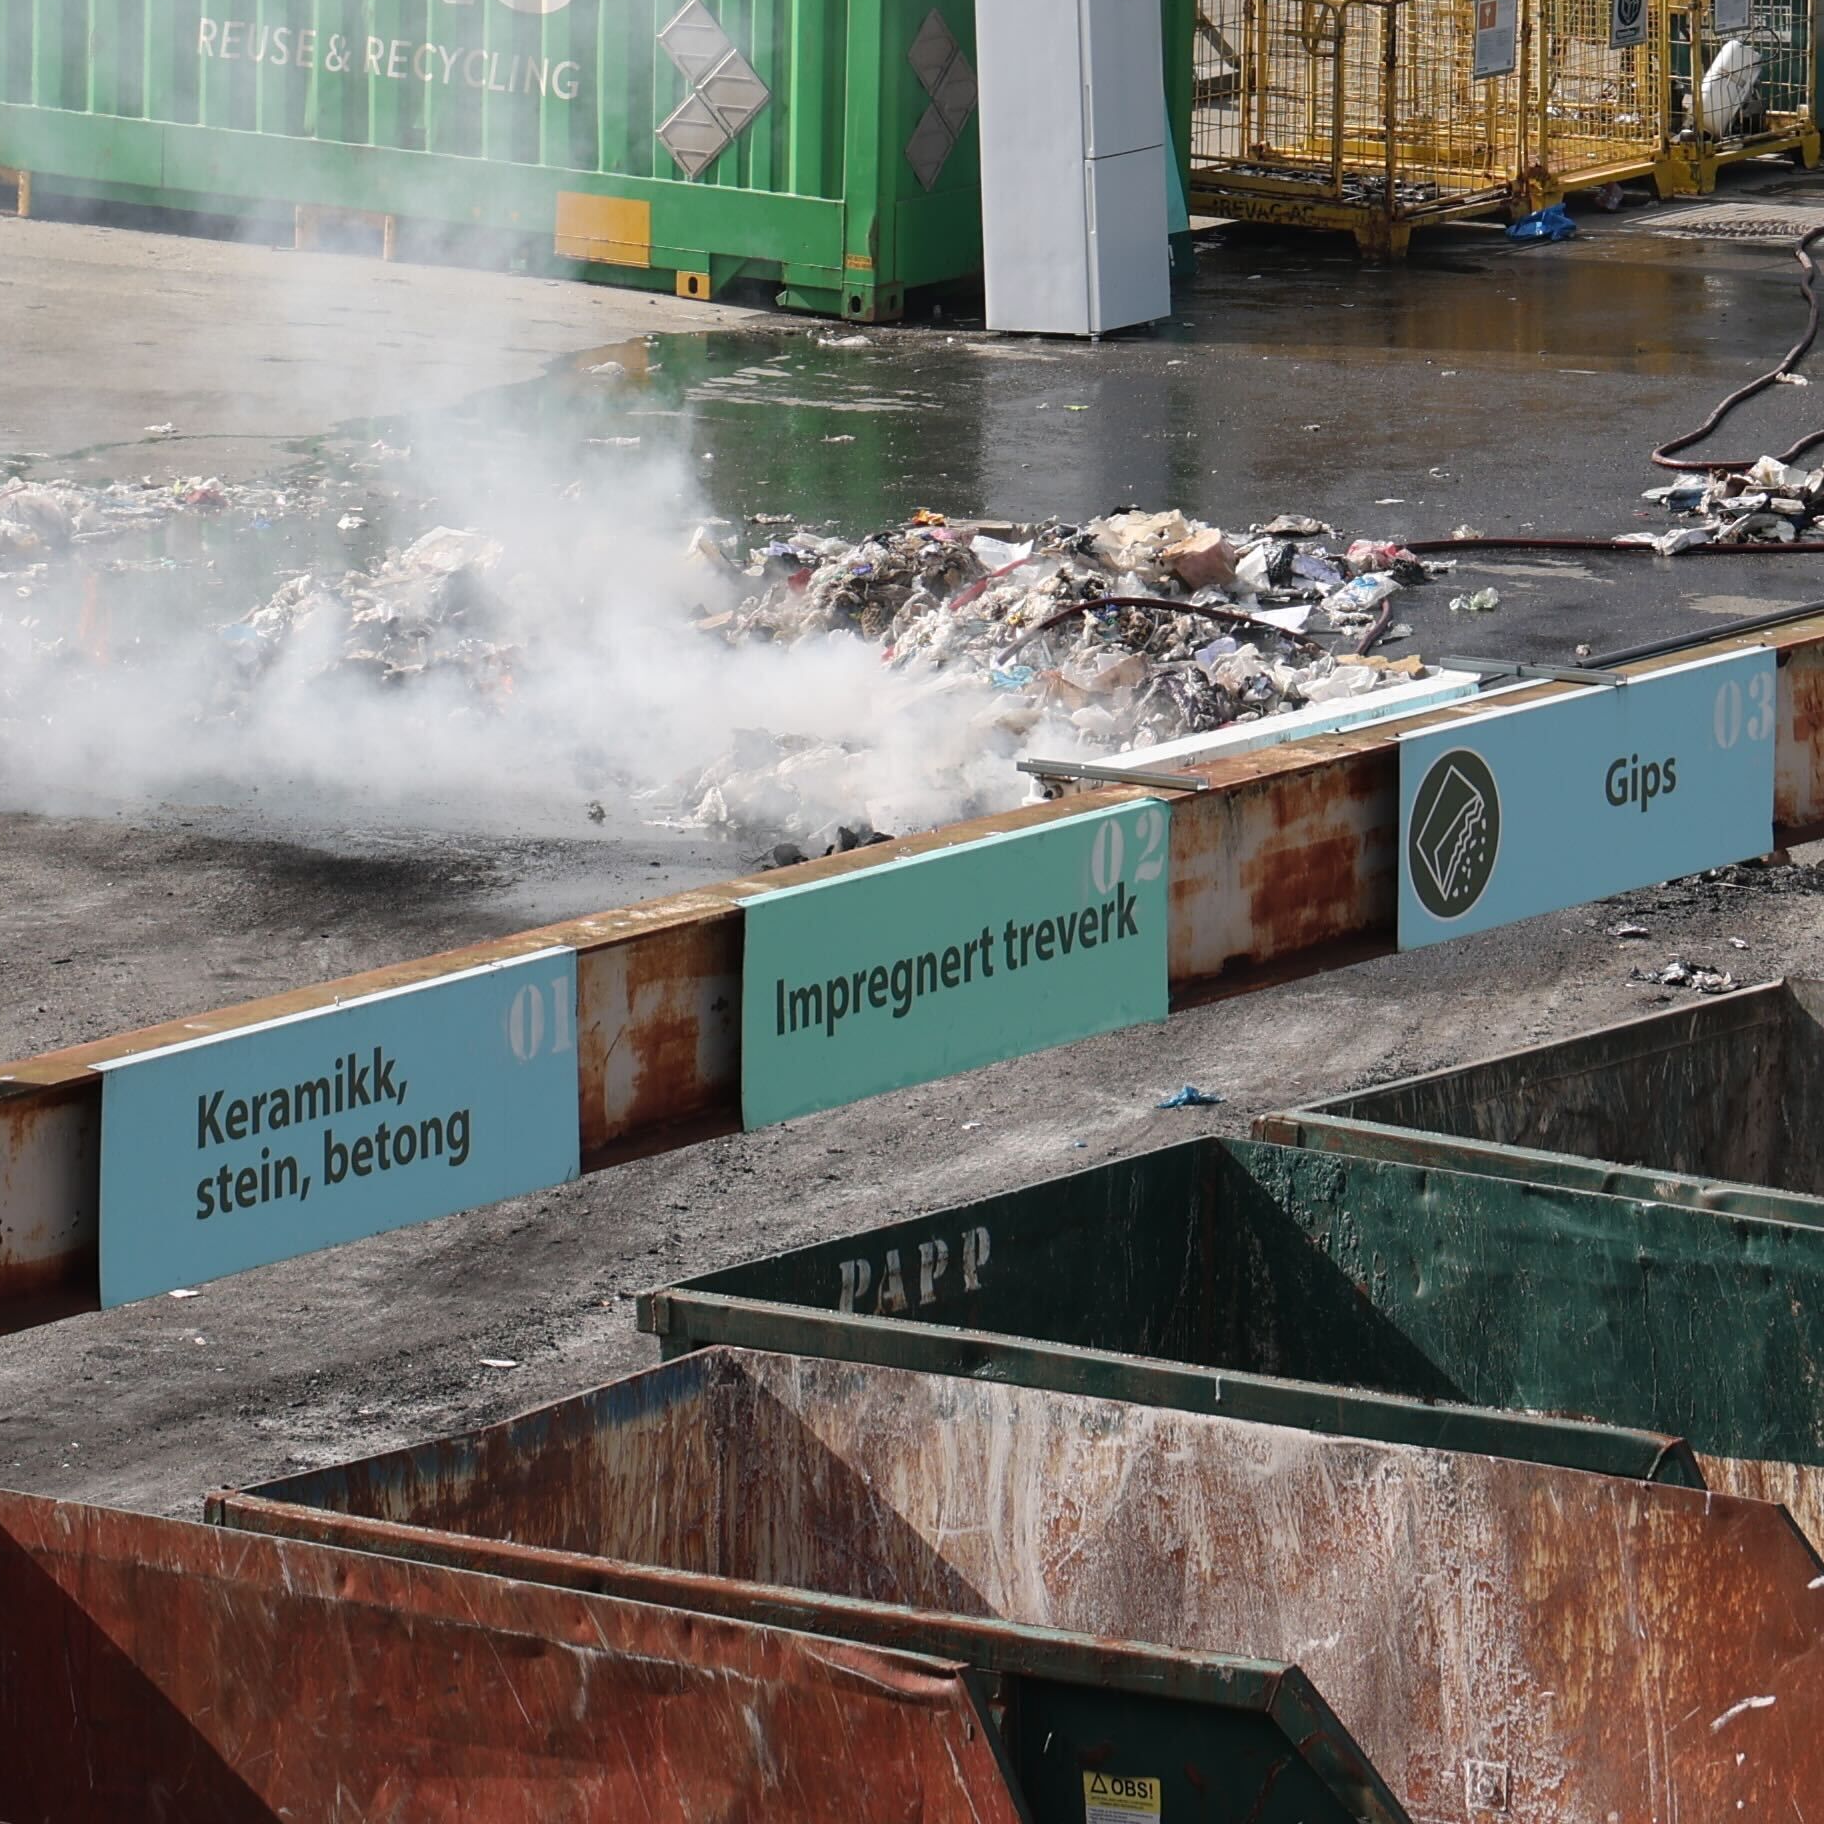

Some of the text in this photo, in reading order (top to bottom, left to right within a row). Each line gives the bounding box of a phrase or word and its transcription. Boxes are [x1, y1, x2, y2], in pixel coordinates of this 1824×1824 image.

[198, 17, 583, 101] REUSE & RECYCLING
[1713, 670, 1776, 752] 03
[1604, 750, 1678, 817] Gips
[1090, 804, 1166, 898] 02
[776, 879, 1139, 1044] Impregnert treverk
[507, 973, 572, 1064] 01
[195, 1044, 409, 1151] Keramikk,
[195, 1102, 473, 1221] stein, betong
[839, 1225, 993, 1317] PAPP
[1111, 1777, 1153, 1800] OBS!
